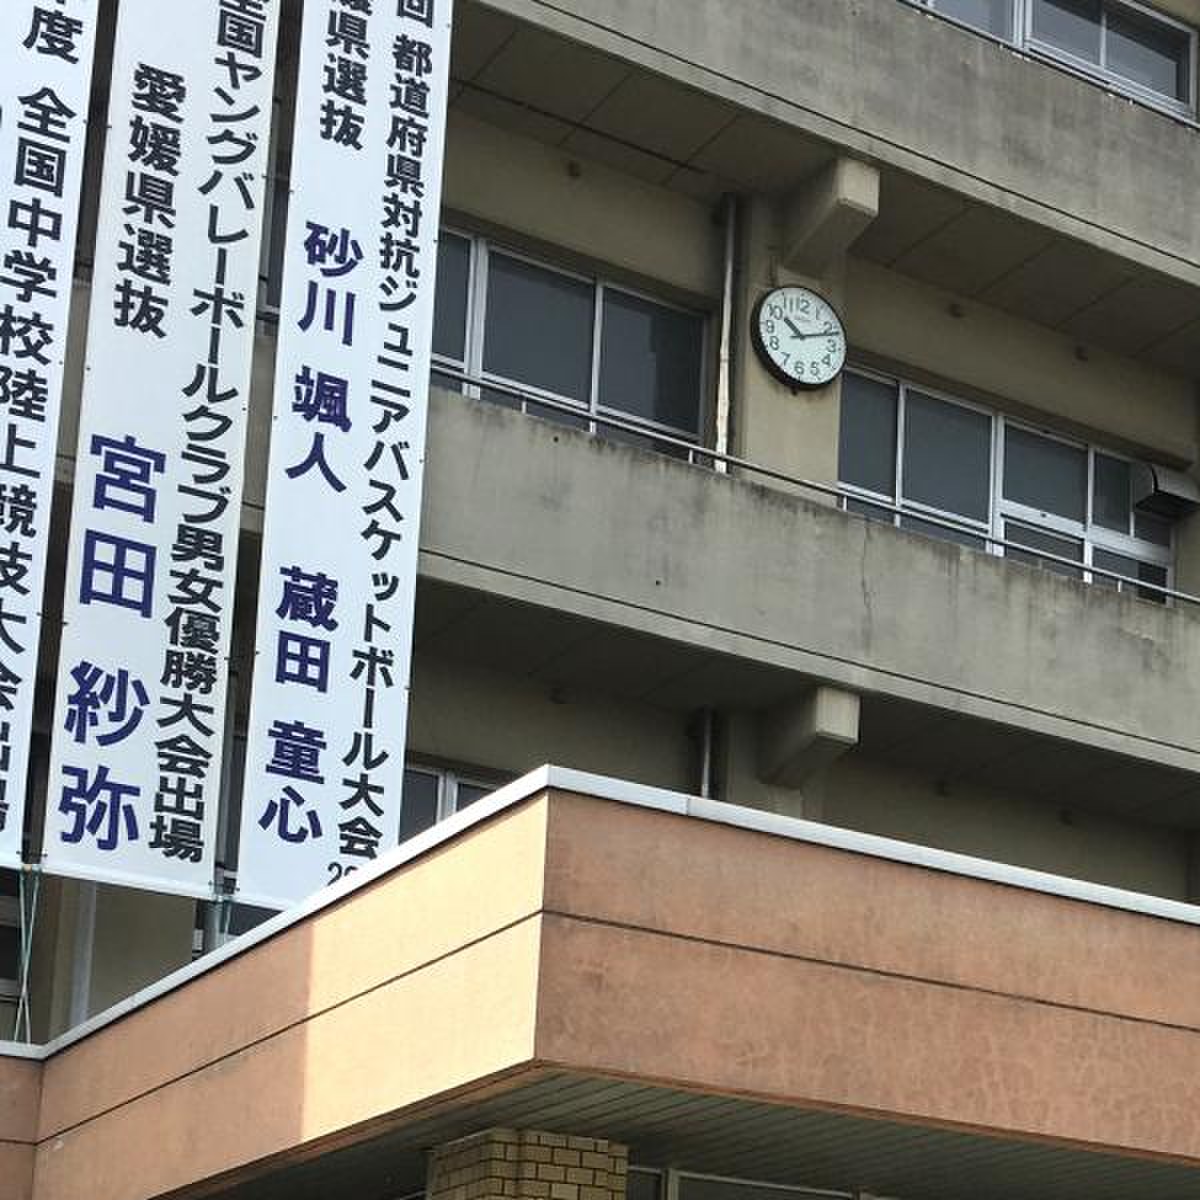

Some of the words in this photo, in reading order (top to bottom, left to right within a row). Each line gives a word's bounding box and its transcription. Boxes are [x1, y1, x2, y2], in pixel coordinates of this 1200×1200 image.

[23, 0, 82, 64] 度
[114, 63, 187, 339] 愛媛県選抜
[298, 220, 364, 346] 砂川
[0, 87, 77, 832] 全国中学校陸上競技
[285, 365, 353, 493] 颯人
[338, 34, 433, 860] 都道府県対抗ジュニアバスケットボール大会
[79, 434, 166, 619] 宮田
[275, 565, 340, 693] 蔵田
[58, 660, 150, 851] 紗弥
[258, 719, 327, 844] 童心
